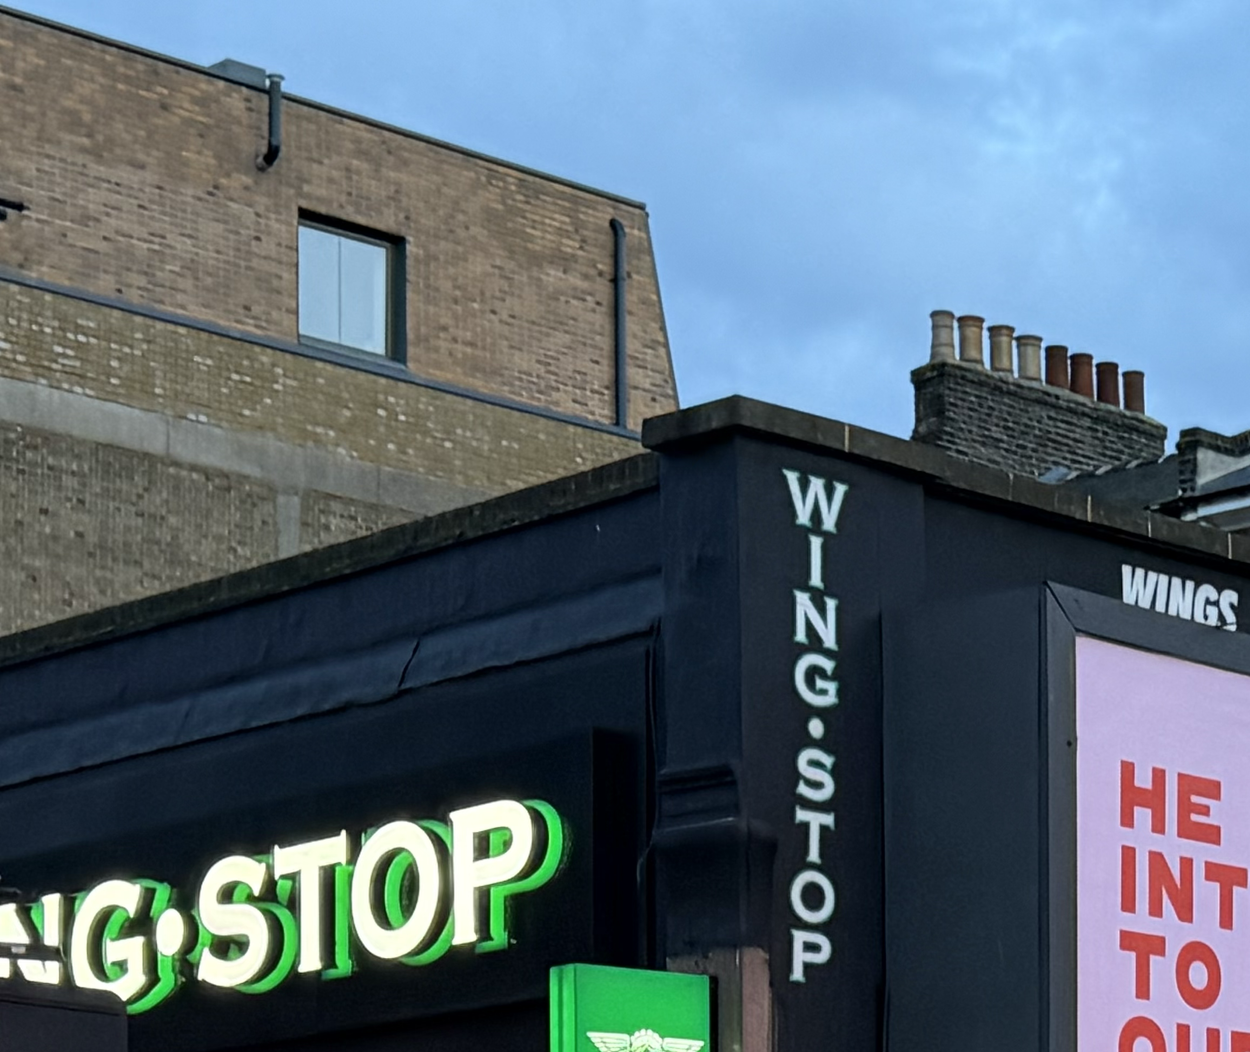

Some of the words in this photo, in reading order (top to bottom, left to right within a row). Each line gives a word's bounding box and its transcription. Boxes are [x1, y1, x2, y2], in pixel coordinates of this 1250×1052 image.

[1121, 563, 1239, 632] WINGS
[1120, 760, 1222, 846] HE
[1119, 929, 1222, 1011] TO
